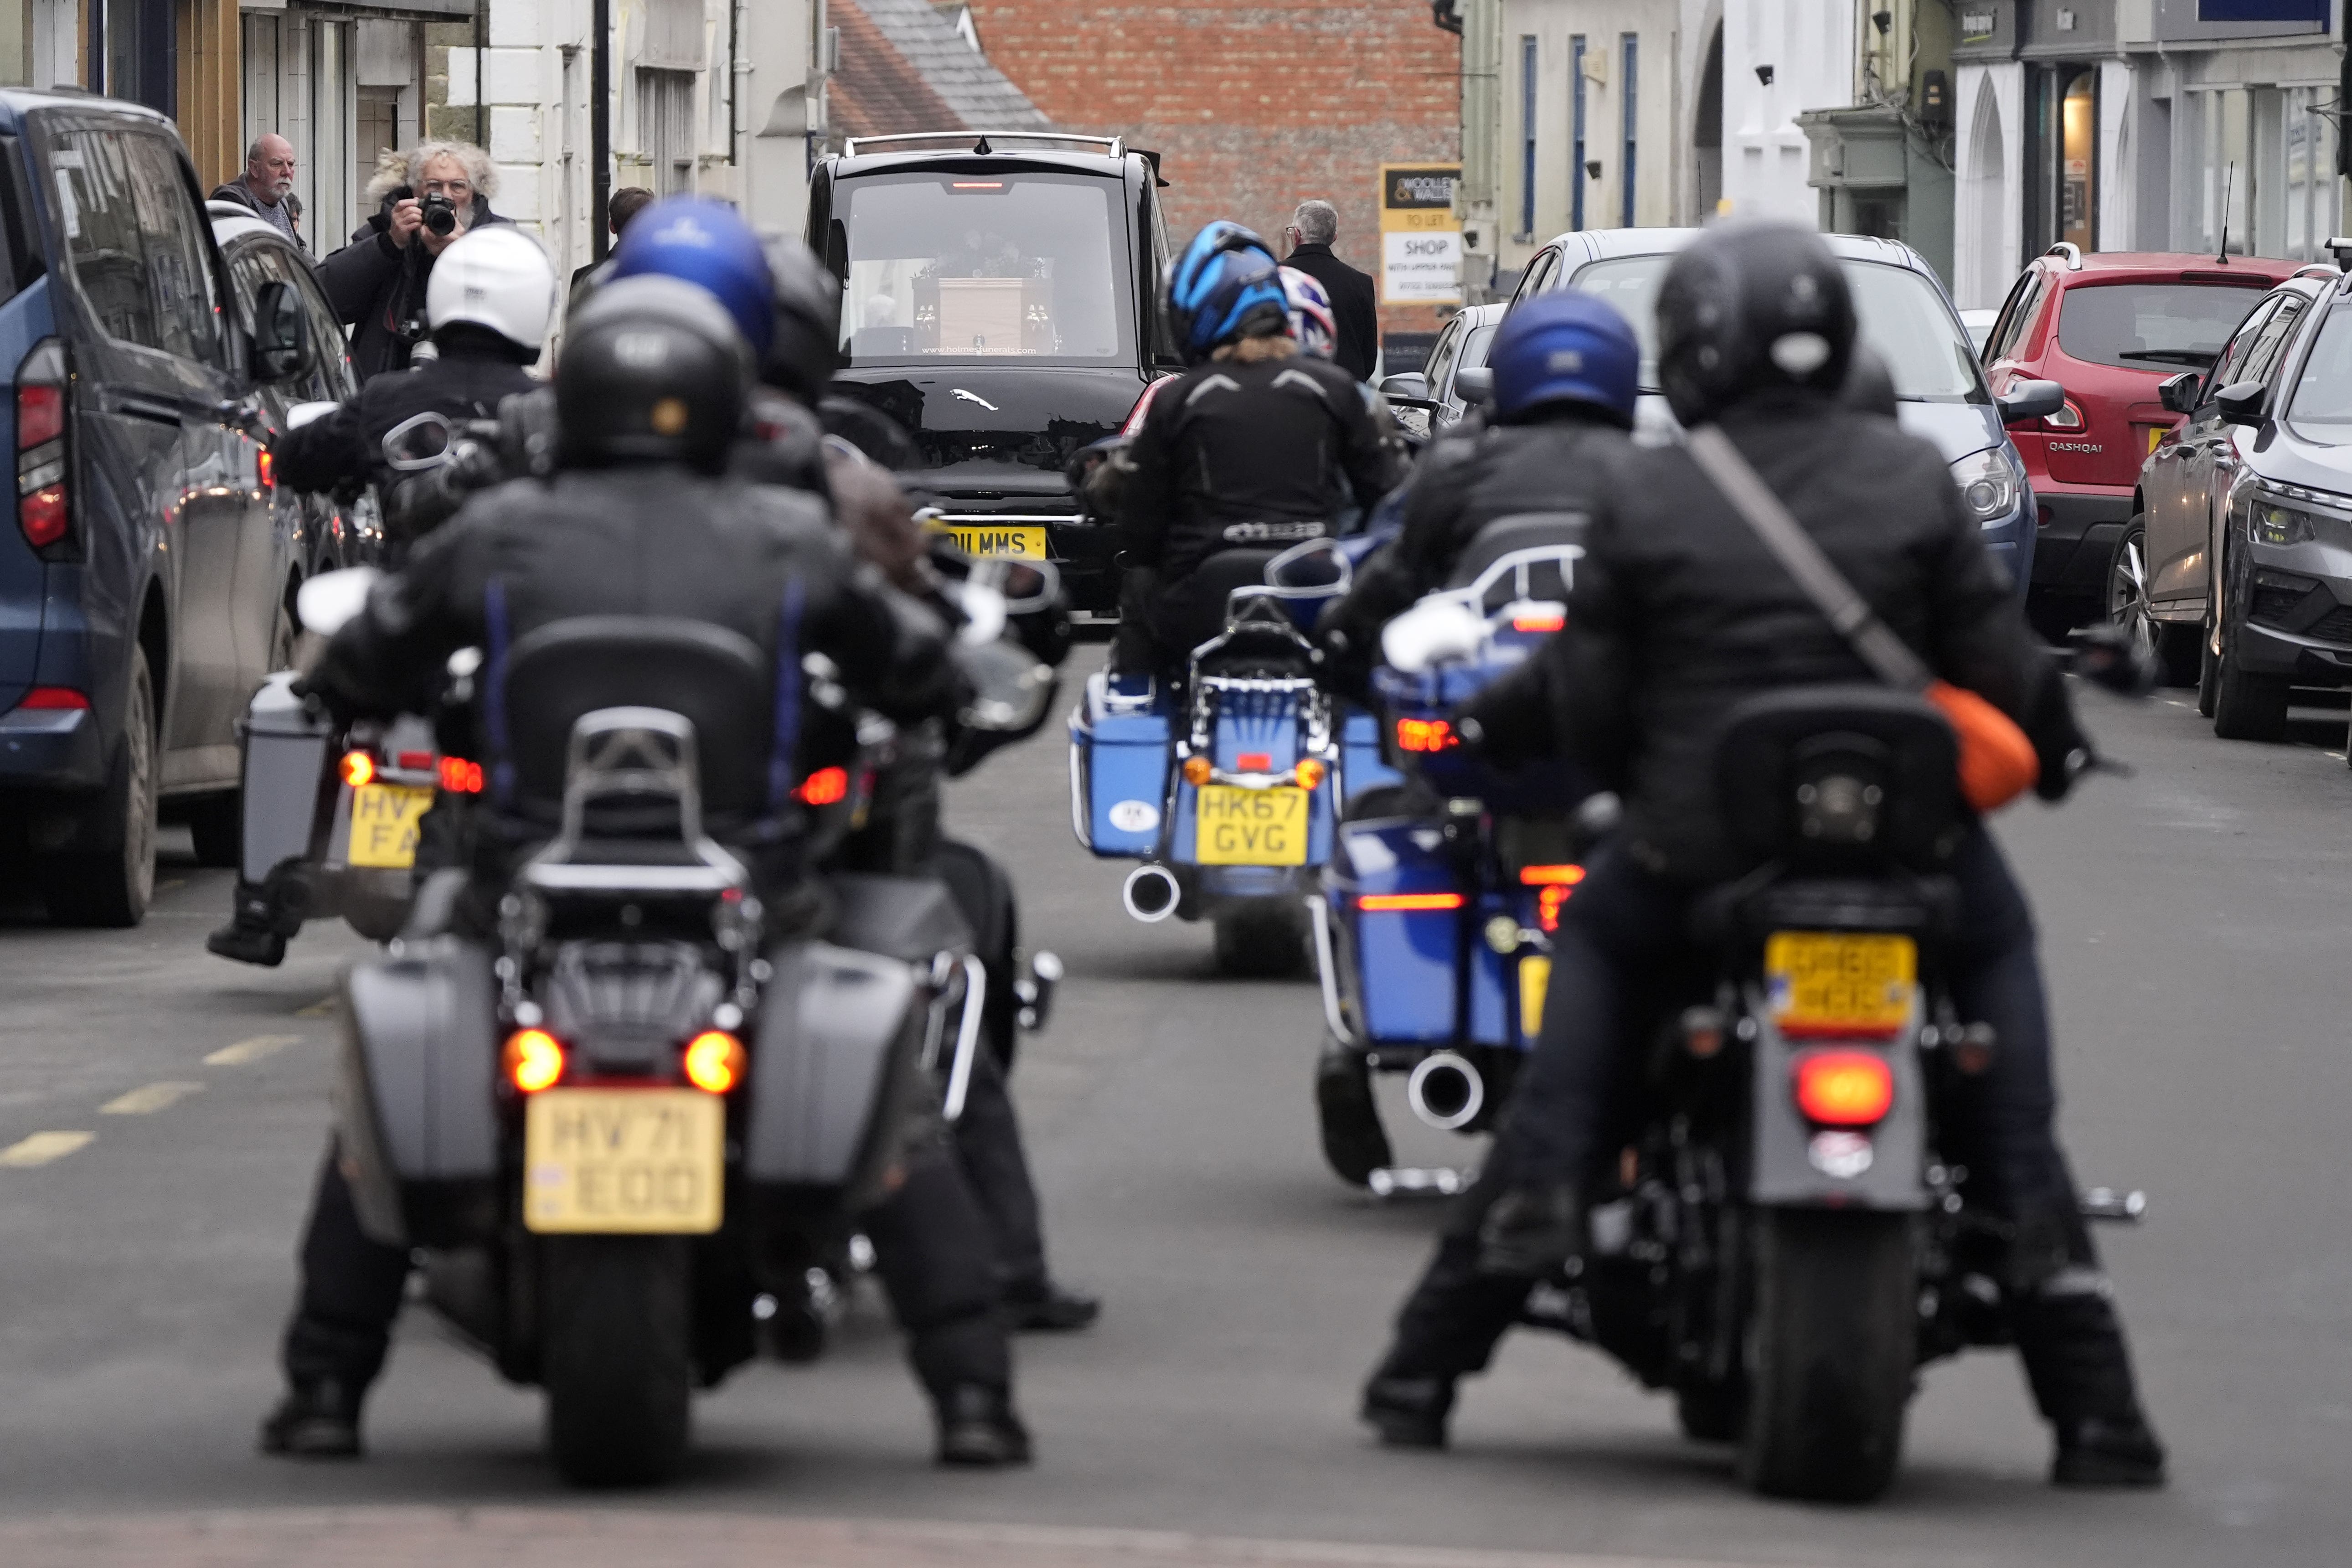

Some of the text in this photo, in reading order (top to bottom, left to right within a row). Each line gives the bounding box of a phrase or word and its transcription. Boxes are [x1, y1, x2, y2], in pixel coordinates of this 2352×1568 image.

[1407, 214, 1444, 226] TO LET
[1404, 239, 1449, 256] SHOP
[922, 346, 1036, 354] www.holmesfunerals.com
[2049, 442, 2102, 453] QASHQAI
[980, 533, 1025, 554] MMS
[1204, 792, 1299, 819] HK67
[1214, 824, 1286, 852] GVG
